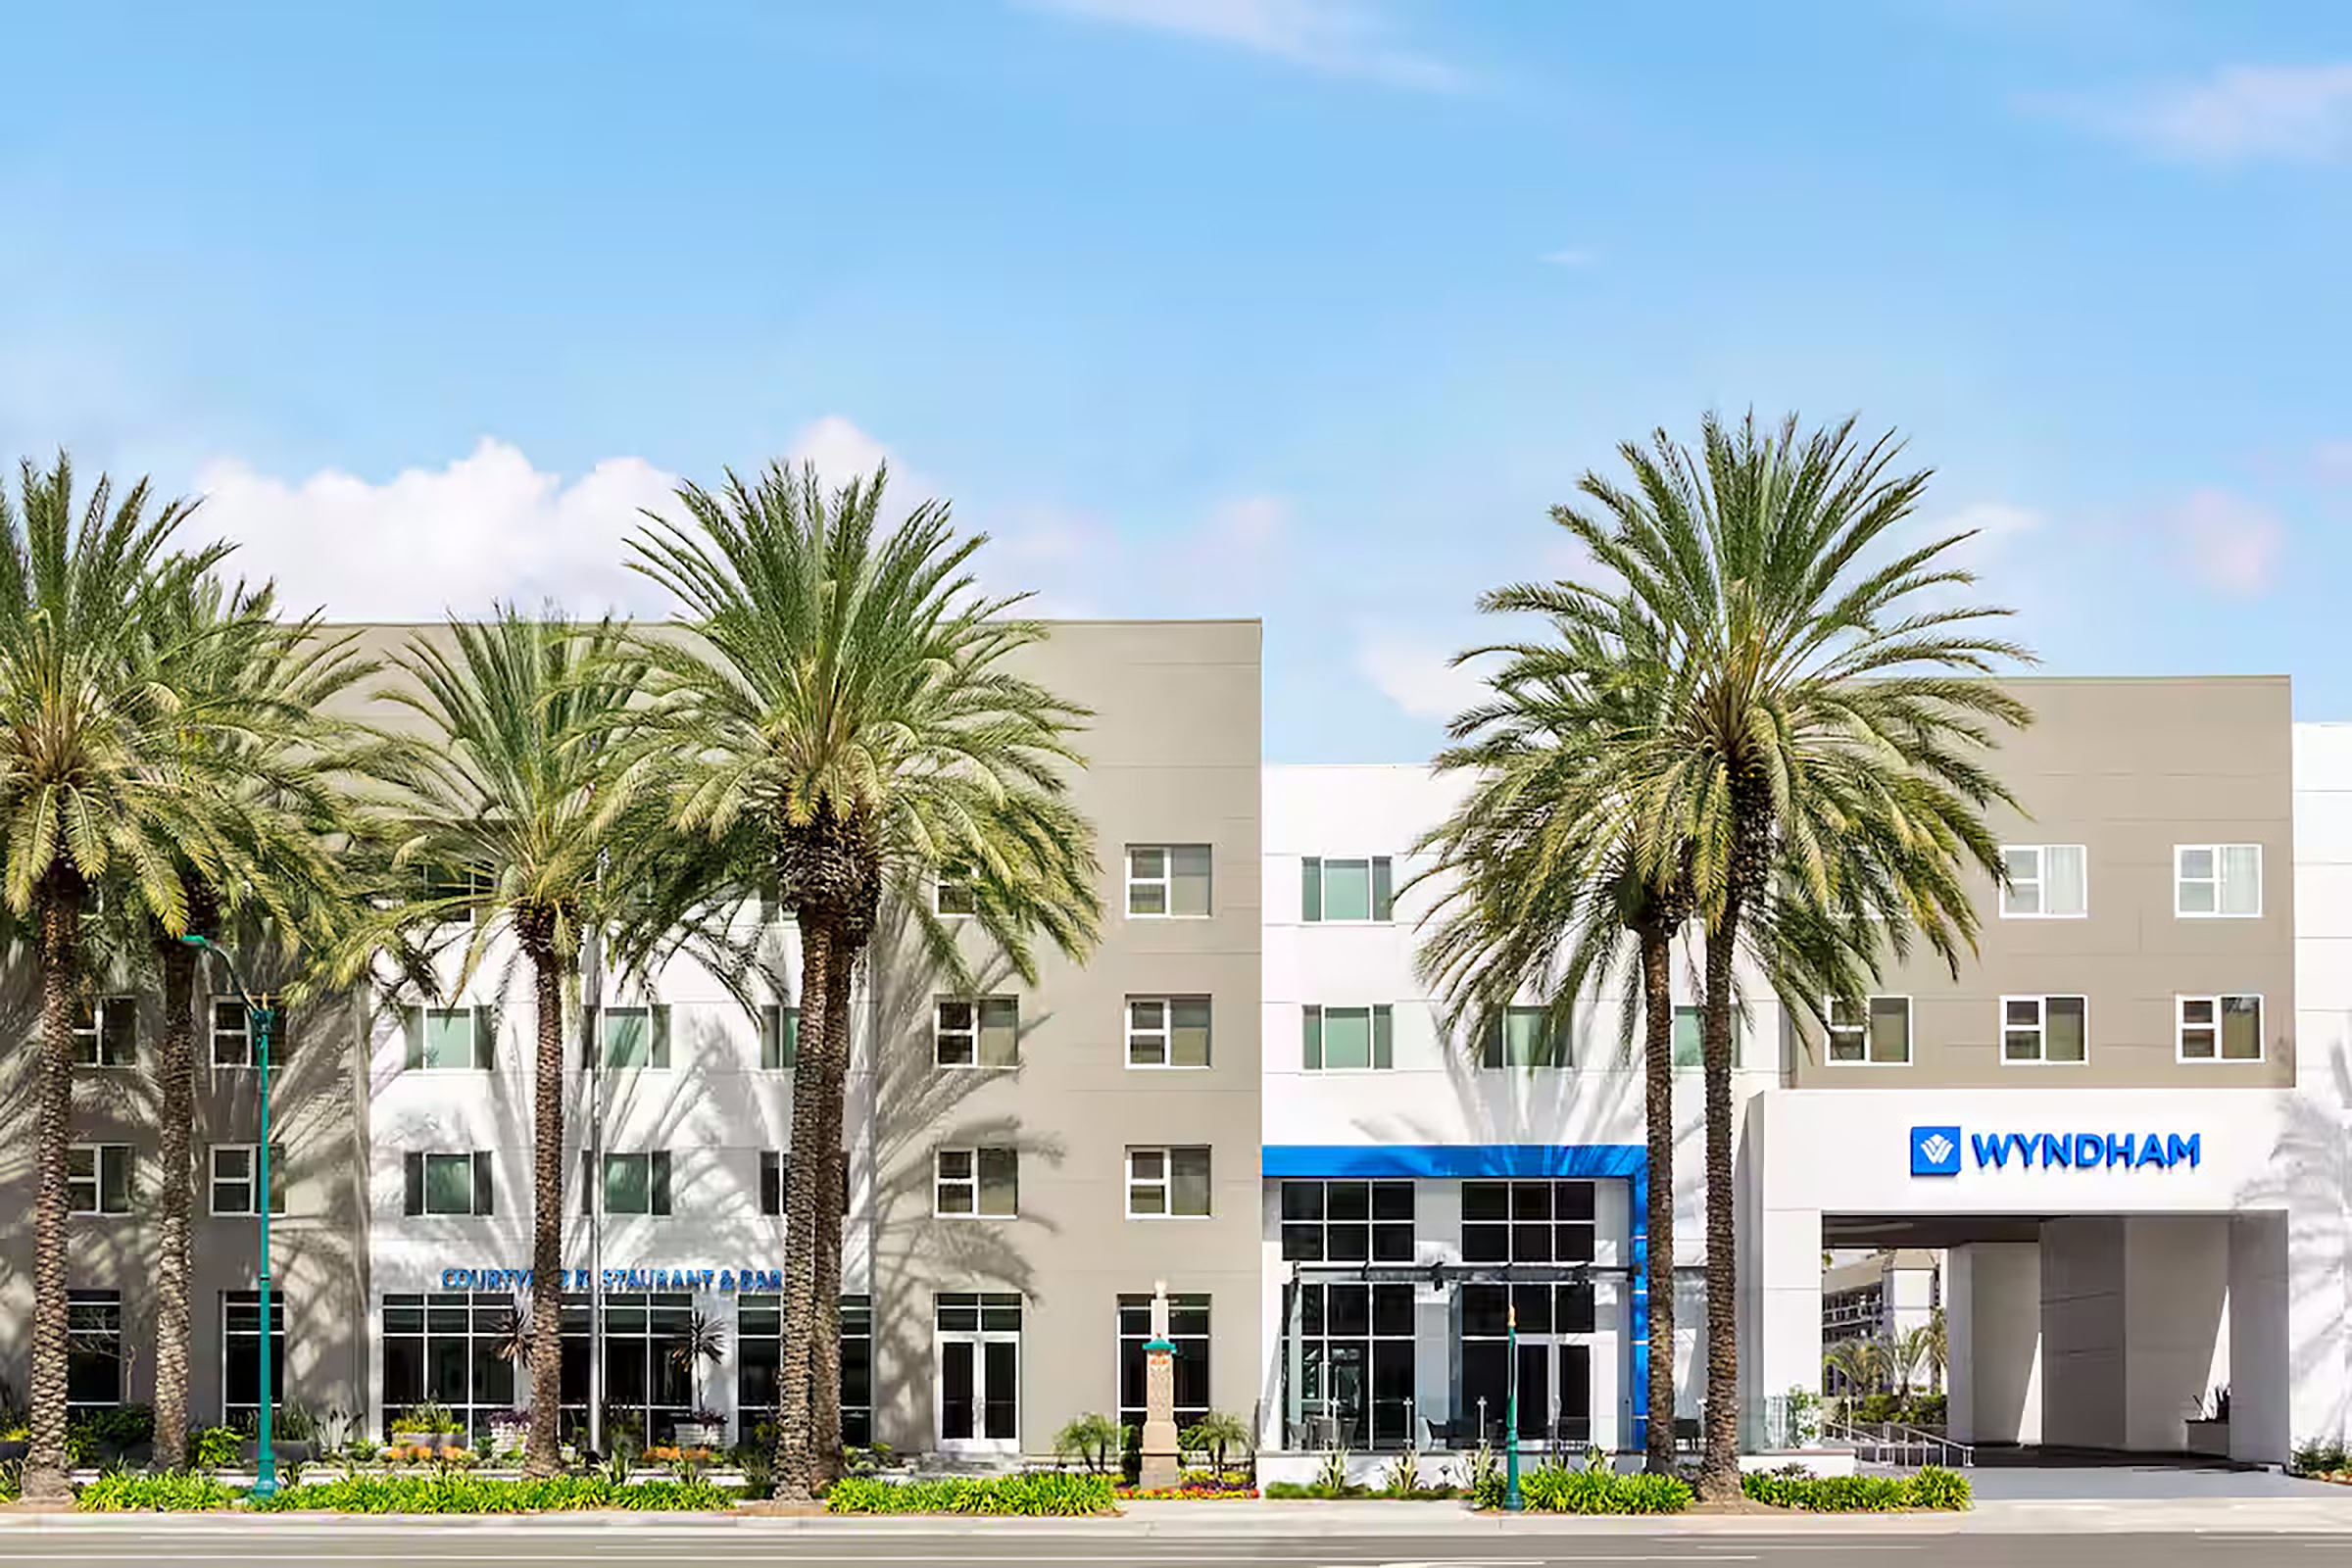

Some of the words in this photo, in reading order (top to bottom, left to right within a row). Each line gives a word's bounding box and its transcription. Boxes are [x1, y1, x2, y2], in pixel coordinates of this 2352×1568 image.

[1972, 1133, 2201, 1168] WYNDHAM
[575, 1269, 715, 1287] RSTAURANT
[720, 1269, 735, 1289] &
[740, 1269, 783, 1287] BAR
